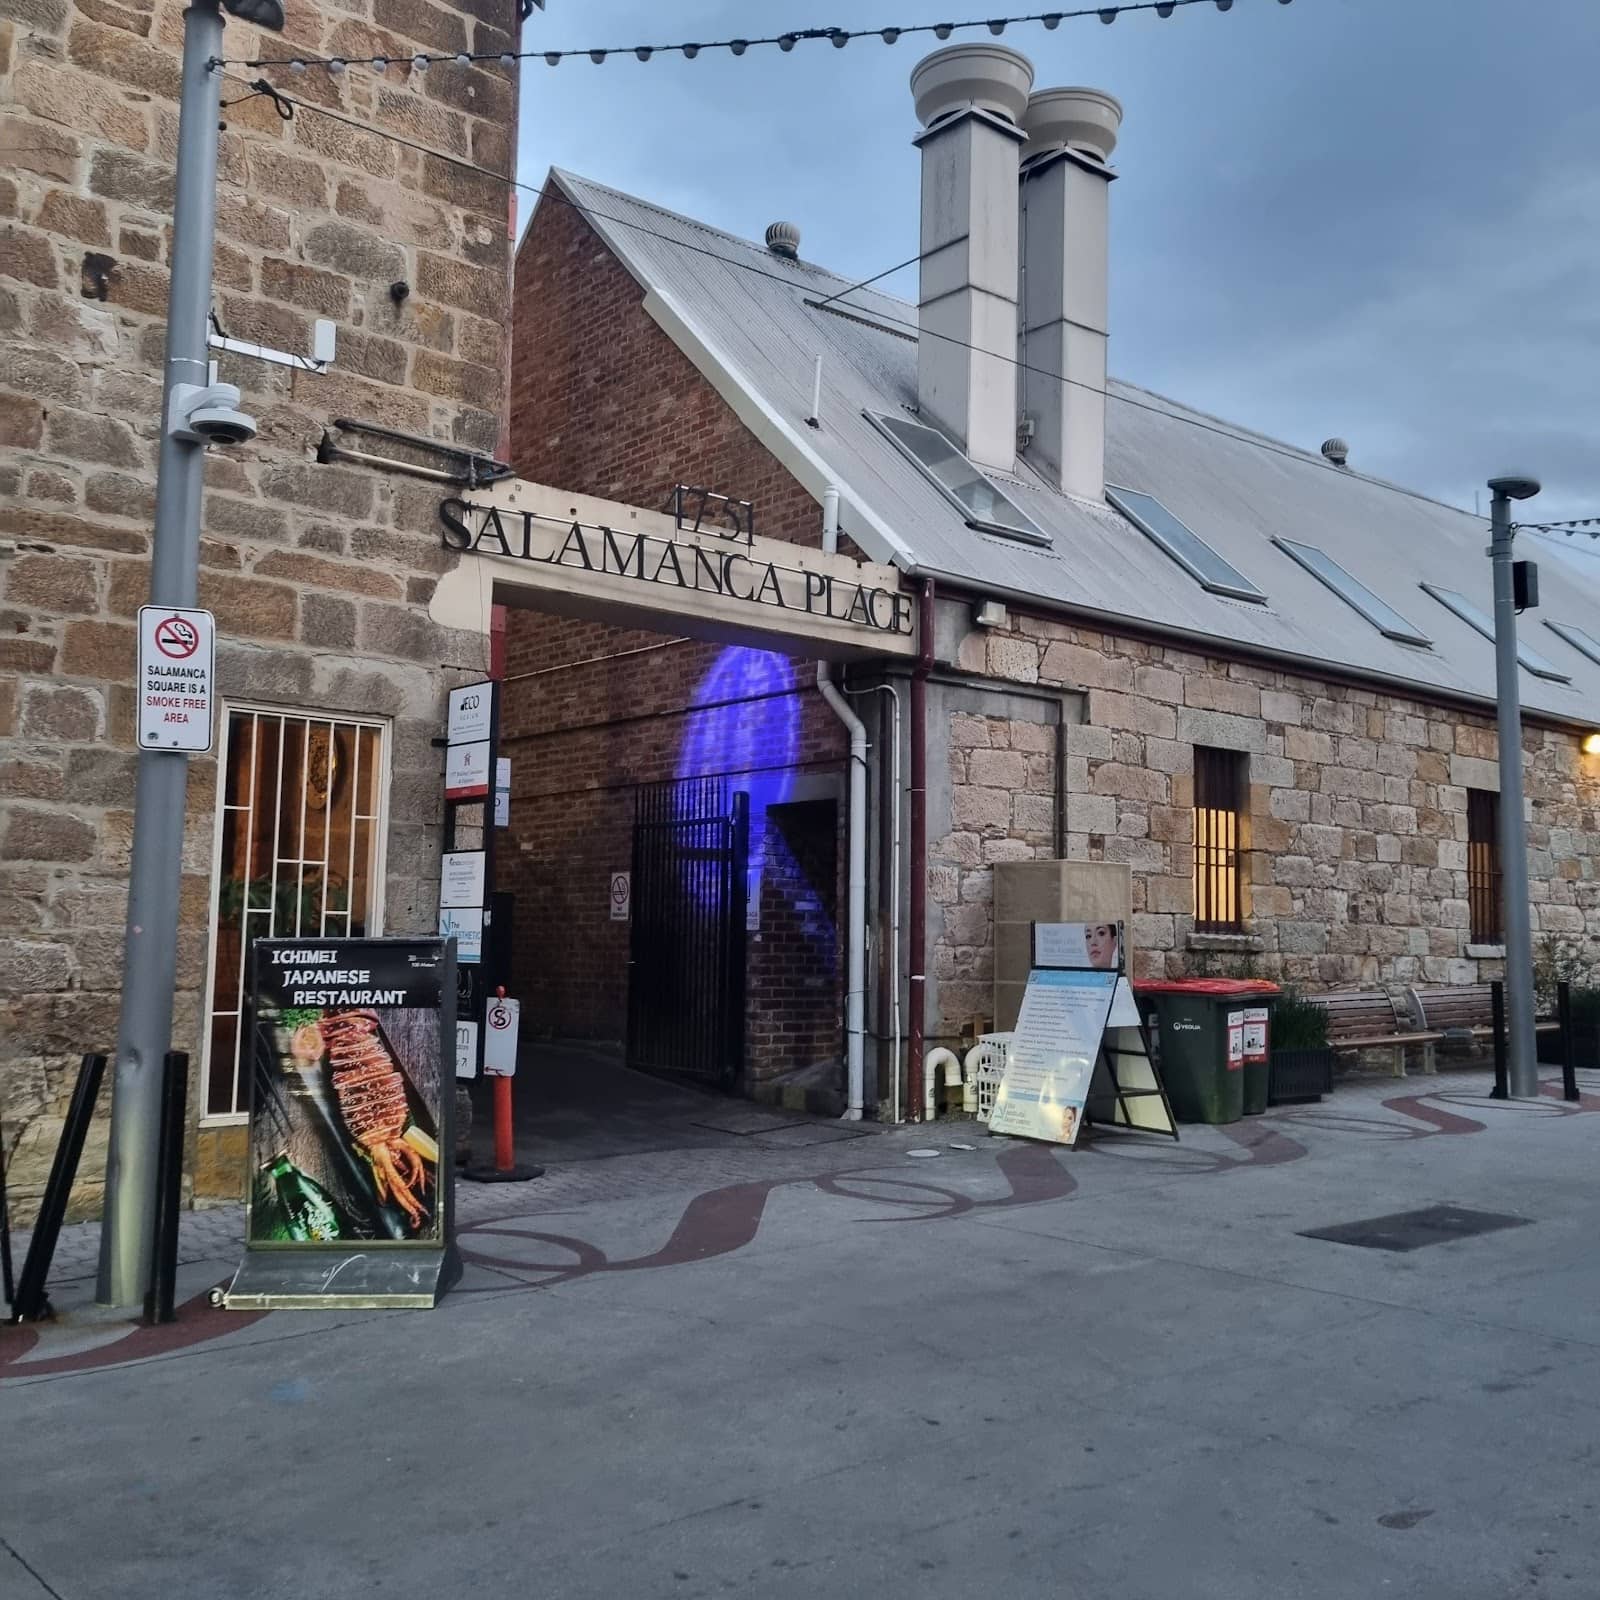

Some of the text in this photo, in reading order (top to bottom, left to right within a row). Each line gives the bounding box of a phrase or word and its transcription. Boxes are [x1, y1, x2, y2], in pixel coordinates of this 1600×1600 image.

[440, 498, 914, 636] SALAMANCA PLACE
[147, 665, 206, 679] SALAMANCA
[147, 680, 206, 694] SQUARE IS A
[146, 696, 207, 710] SMOKE FREE
[164, 712, 189, 723] AREA
[271, 950, 338, 965] ICHIMEI
[282, 970, 371, 987] JAPANESE
[293, 990, 408, 1006] RESTAURANT
